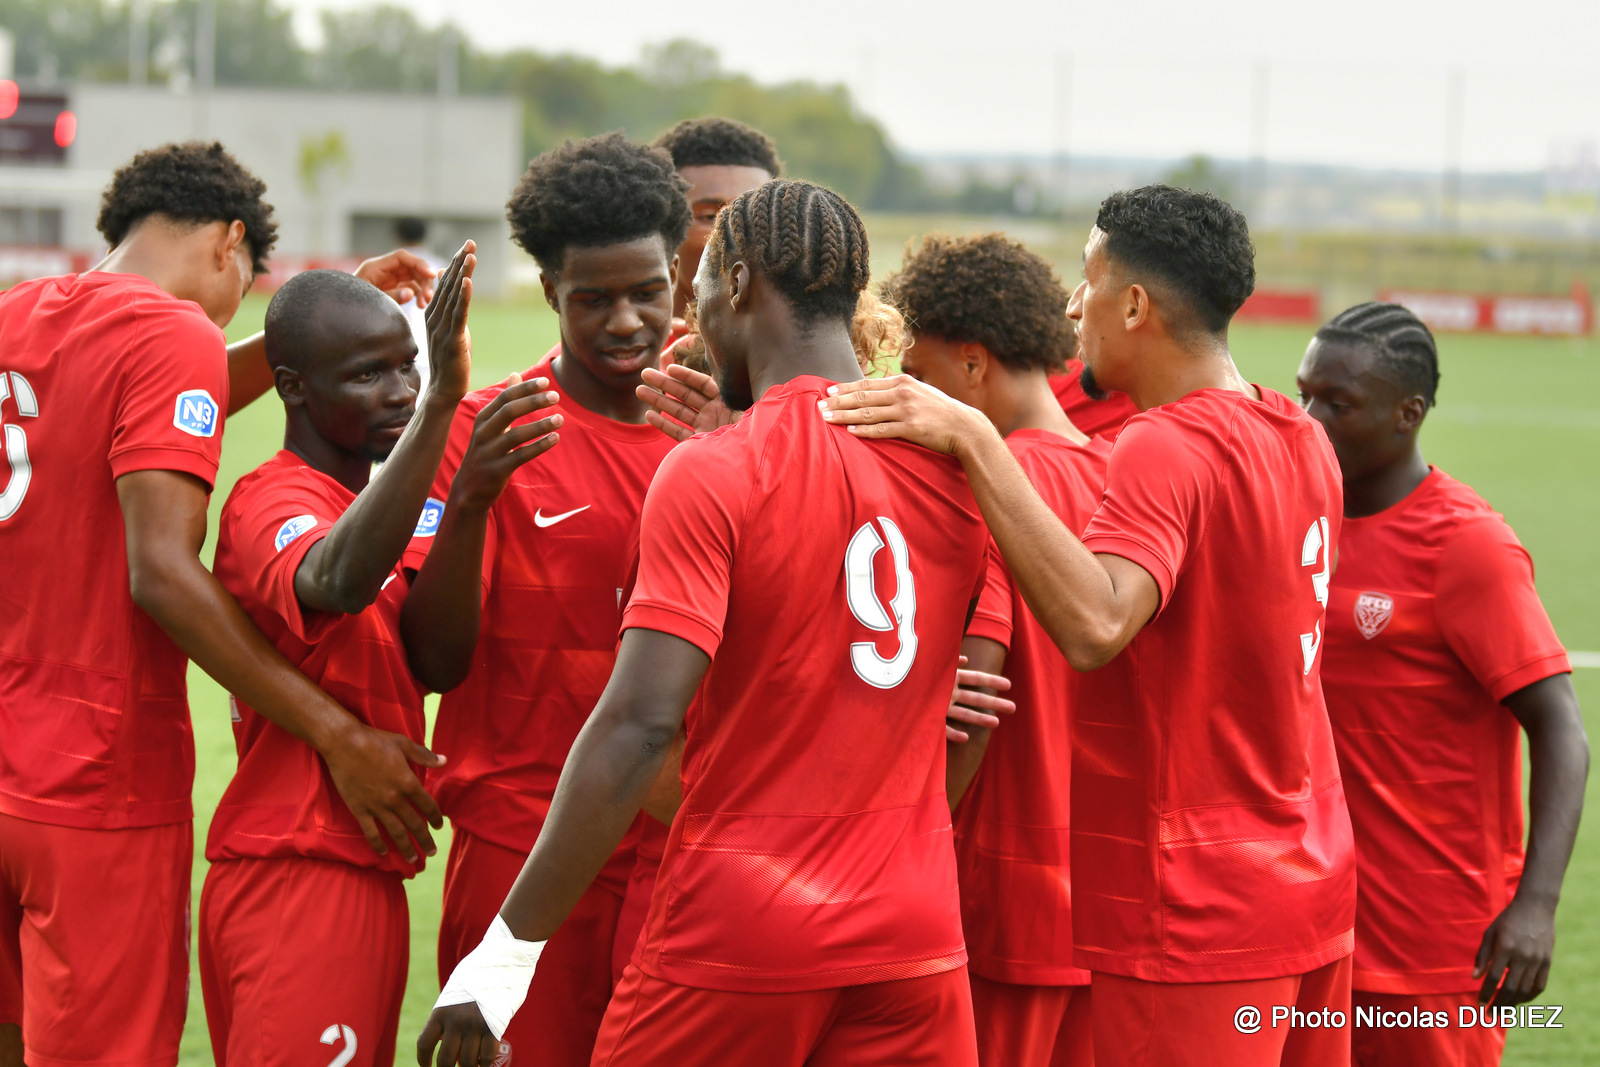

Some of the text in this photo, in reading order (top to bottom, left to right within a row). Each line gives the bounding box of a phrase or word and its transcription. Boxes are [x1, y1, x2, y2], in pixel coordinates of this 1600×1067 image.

[183, 398, 212, 426] N3
[844, 516, 918, 690] 9
[1300, 516, 1330, 676] 3
[319, 1024, 358, 1067] 2
